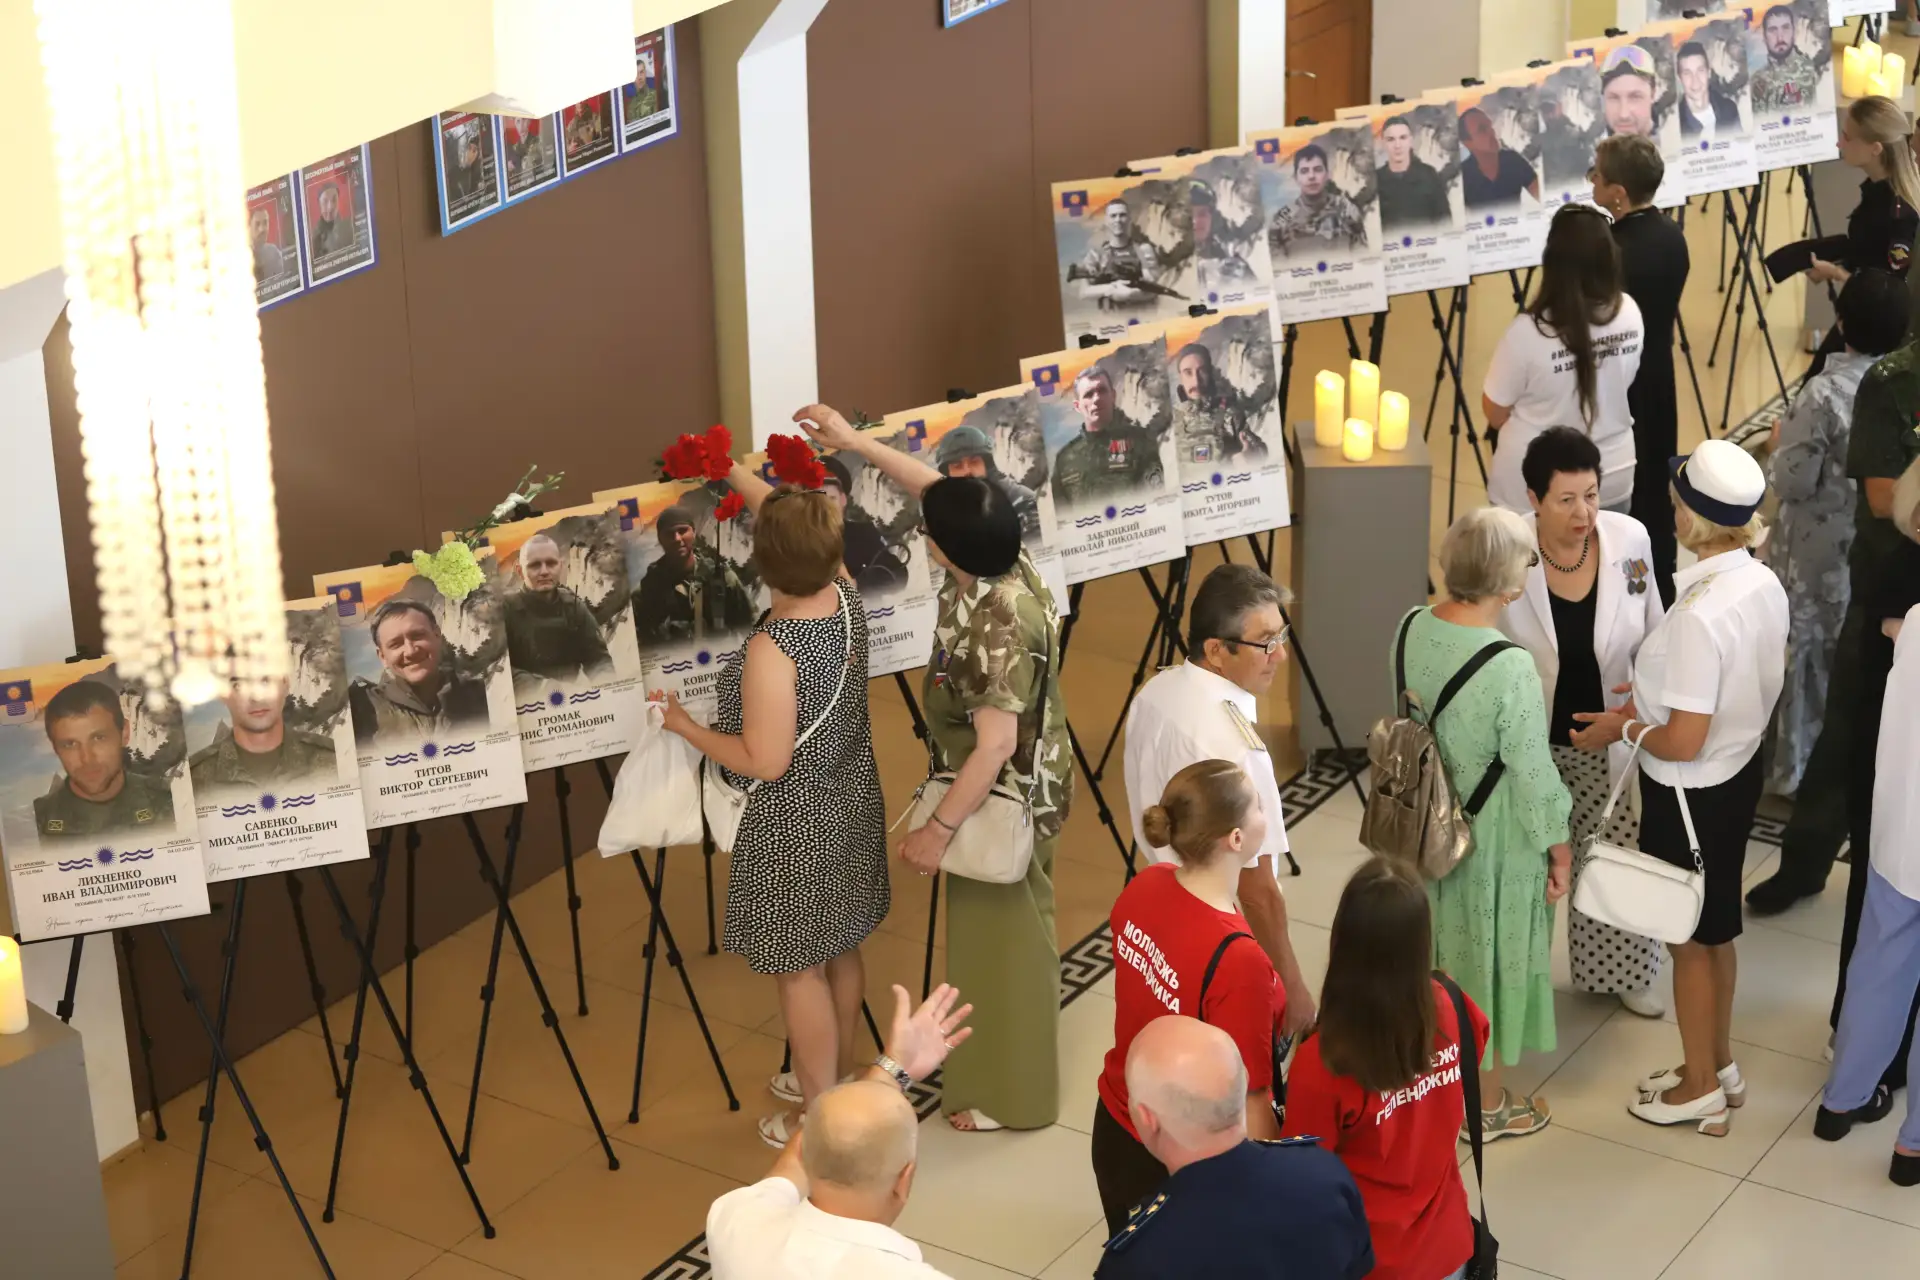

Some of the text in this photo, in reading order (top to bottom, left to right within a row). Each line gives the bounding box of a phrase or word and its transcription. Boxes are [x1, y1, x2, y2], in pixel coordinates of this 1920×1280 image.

[1183, 507, 1214, 519] ИКИТА
[1217, 496, 1261, 512] ИГОРЕВИЧ
[1060, 540, 1105, 558] НИКОЛАЙ
[1107, 525, 1166, 547] НИКОЛАЕВИЧ
[868, 631, 914, 648] ОЛАЕВИЧ
[520, 728, 544, 741] НИС
[547, 713, 615, 735] РОМАНОВИЧ
[537, 710, 582, 727] ГРОМАК
[379, 768, 489, 796] ВИКТОР СЕРГЕЕВИЧ
[414, 764, 452, 779] ТИТОВ
[208, 820, 338, 848] МИХАИЛ ВАСИЛЬЕВИЧ
[244, 815, 298, 832] САВЕНКО
[42, 874, 178, 903] ИВАН ВЛАДИМИРОВИЧ
[78, 869, 142, 887] ЛИХНЕНКО
[1375, 1061, 1462, 1126] ГЕЛЕНДЖИК
